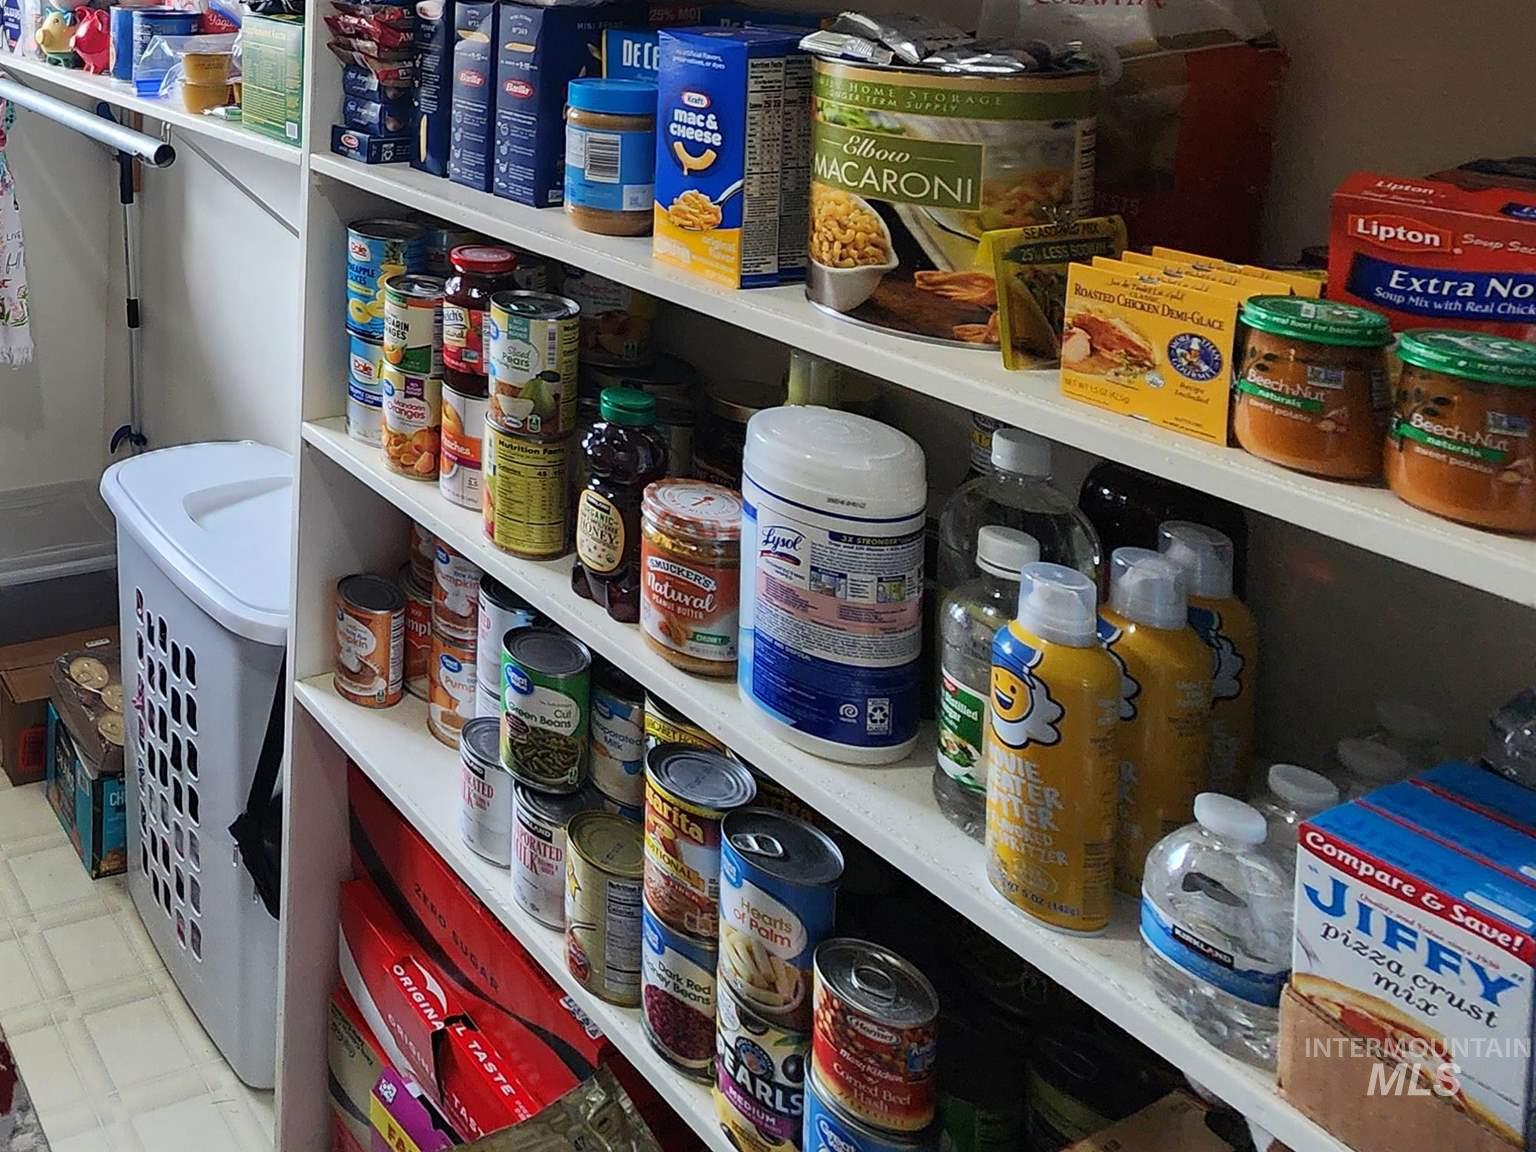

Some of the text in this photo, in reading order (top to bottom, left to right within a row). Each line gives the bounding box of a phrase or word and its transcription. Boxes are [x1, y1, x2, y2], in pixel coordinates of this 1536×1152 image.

[686, 94, 706, 106] Kraft
[849, 81, 1003, 107] HOME STORAGE
[905, 100, 959, 113] SUPPLY
[673, 109, 719, 131] mac &
[842, 134, 911, 165] Elbow
[814, 152, 973, 205] MACARONI
[1376, 180, 1435, 195] Lipton
[1357, 218, 1441, 247] Lipton
[1461, 233, 1504, 249] Soup
[1388, 269, 1474, 297] Extra
[1073, 283, 1116, 305] ROASTED
[1116, 294, 1161, 315] CHICKEN
[1161, 303, 1225, 332] DEMI-GLACE
[1373, 286, 1536, 316] Soup Mix with Real Chick
[353, 358, 373, 374] Dole
[501, 353, 530, 368] Pears
[1257, 389, 1303, 408] naturals
[498, 438, 540, 456] Nutrition
[1426, 436, 1482, 458] naturals
[580, 519, 616, 546] HONEY
[761, 527, 803, 553] Lysol
[649, 556, 714, 591] SMUCKER'S
[646, 571, 718, 613] Natural
[676, 605, 705, 620] BUTTER
[539, 714, 572, 730] Beans
[553, 708, 573, 720] Cut
[603, 734, 624, 750] Milk
[646, 782, 705, 845] arita
[1305, 830, 1527, 953] Compare & Save!
[732, 908, 792, 948] of Palm
[740, 896, 793, 934] Hearts
[414, 882, 500, 993] ZERO SUGAR
[658, 959, 712, 995] Dark Red
[1320, 919, 1498, 1029] pizza crust
[673, 982, 712, 1006] Beans
[1372, 970, 1440, 1018] mix
[857, 1017, 895, 1042] Hormel
[466, 1039, 516, 1098] TASTE
[832, 1061, 913, 1105] Corned Beef
[726, 1084, 777, 1127] MEDIUM
[852, 1087, 890, 1114] Hash
